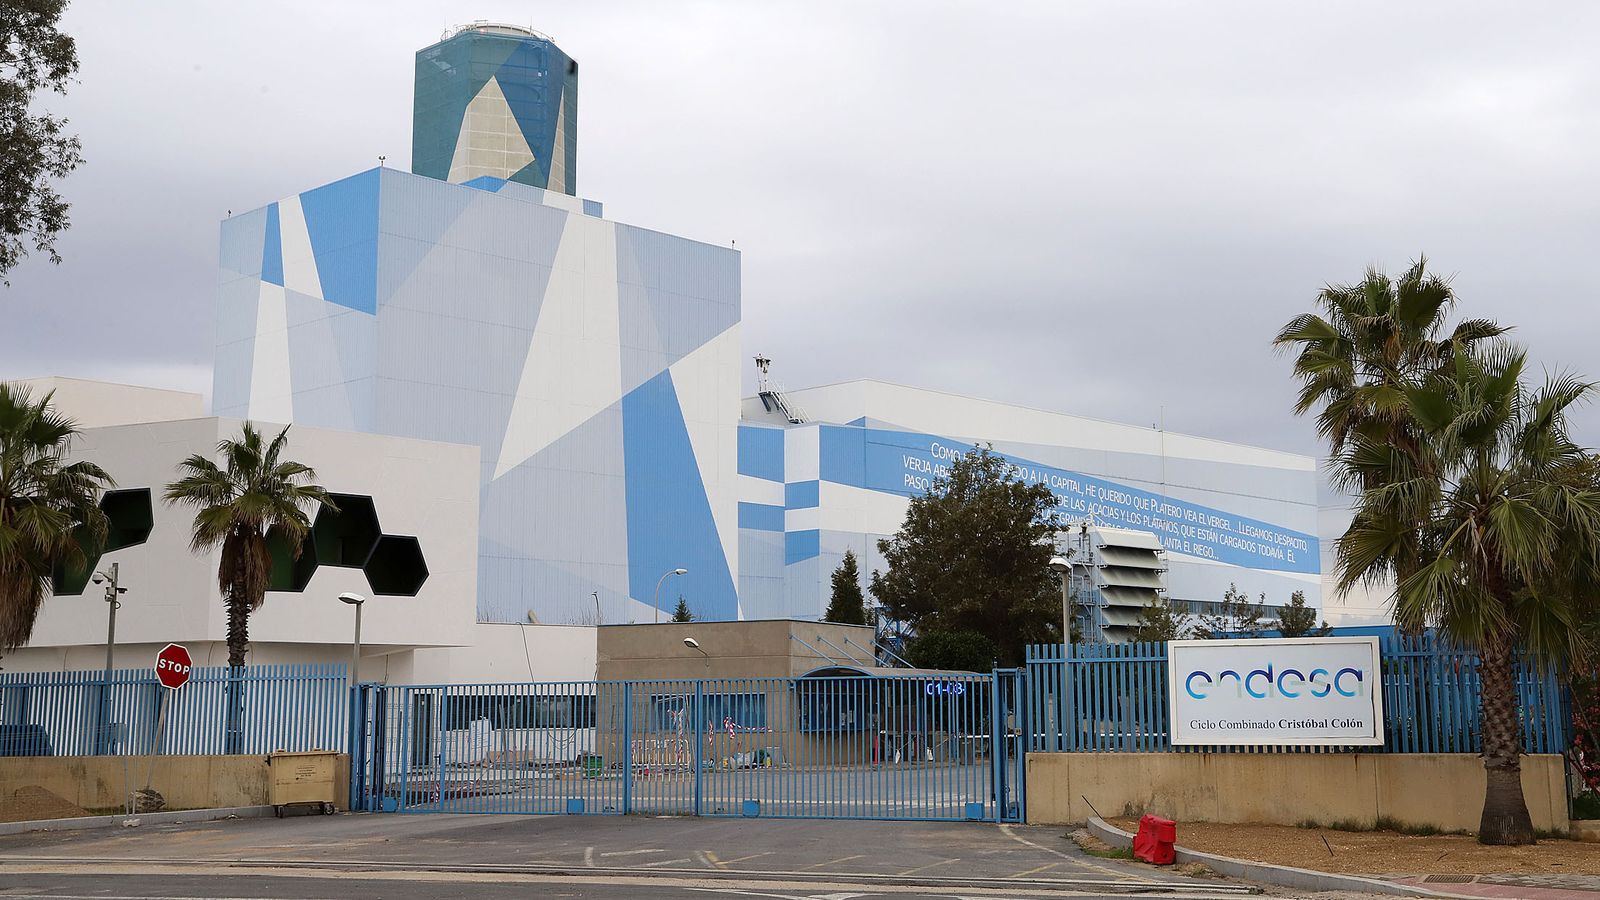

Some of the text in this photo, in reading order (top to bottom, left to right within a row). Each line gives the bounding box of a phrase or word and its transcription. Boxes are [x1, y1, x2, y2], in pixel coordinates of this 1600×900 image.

[903, 454, 932, 474] VERJA
[1057, 494, 1069, 508] DE
[1070, 497, 1086, 512] LAS
[1087, 501, 1120, 520] ACACIAS
[1119, 509, 1126, 521] Y
[1126, 510, 1142, 525] LOS
[1180, 524, 1196, 539] QUE
[1197, 527, 1218, 544] ESTÁN
[1219, 533, 1256, 553] CARGADOS
[1287, 548, 1296, 564] EL
[904, 473, 929, 491] PASO
[1183, 540, 1192, 553] EL
[1030, 469, 1037, 483] A
[1038, 471, 1049, 486] LA
[1051, 475, 1084, 497] CAPITAL,
[1085, 483, 1096, 498] HE
[1098, 487, 1132, 506] QUERIDO
[1133, 496, 1150, 511] QUE
[1150, 498, 1182, 519] PLATERO
[1183, 508, 1198, 523] VEA
[1199, 512, 1207, 525] EL
[1274, 532, 1308, 554] DESPACITO,
[158, 658, 190, 675] STOP
[1185, 662, 1363, 699] endesa
[1190, 718, 1363, 730] Ciclo Combinado Cristóbal Colón
